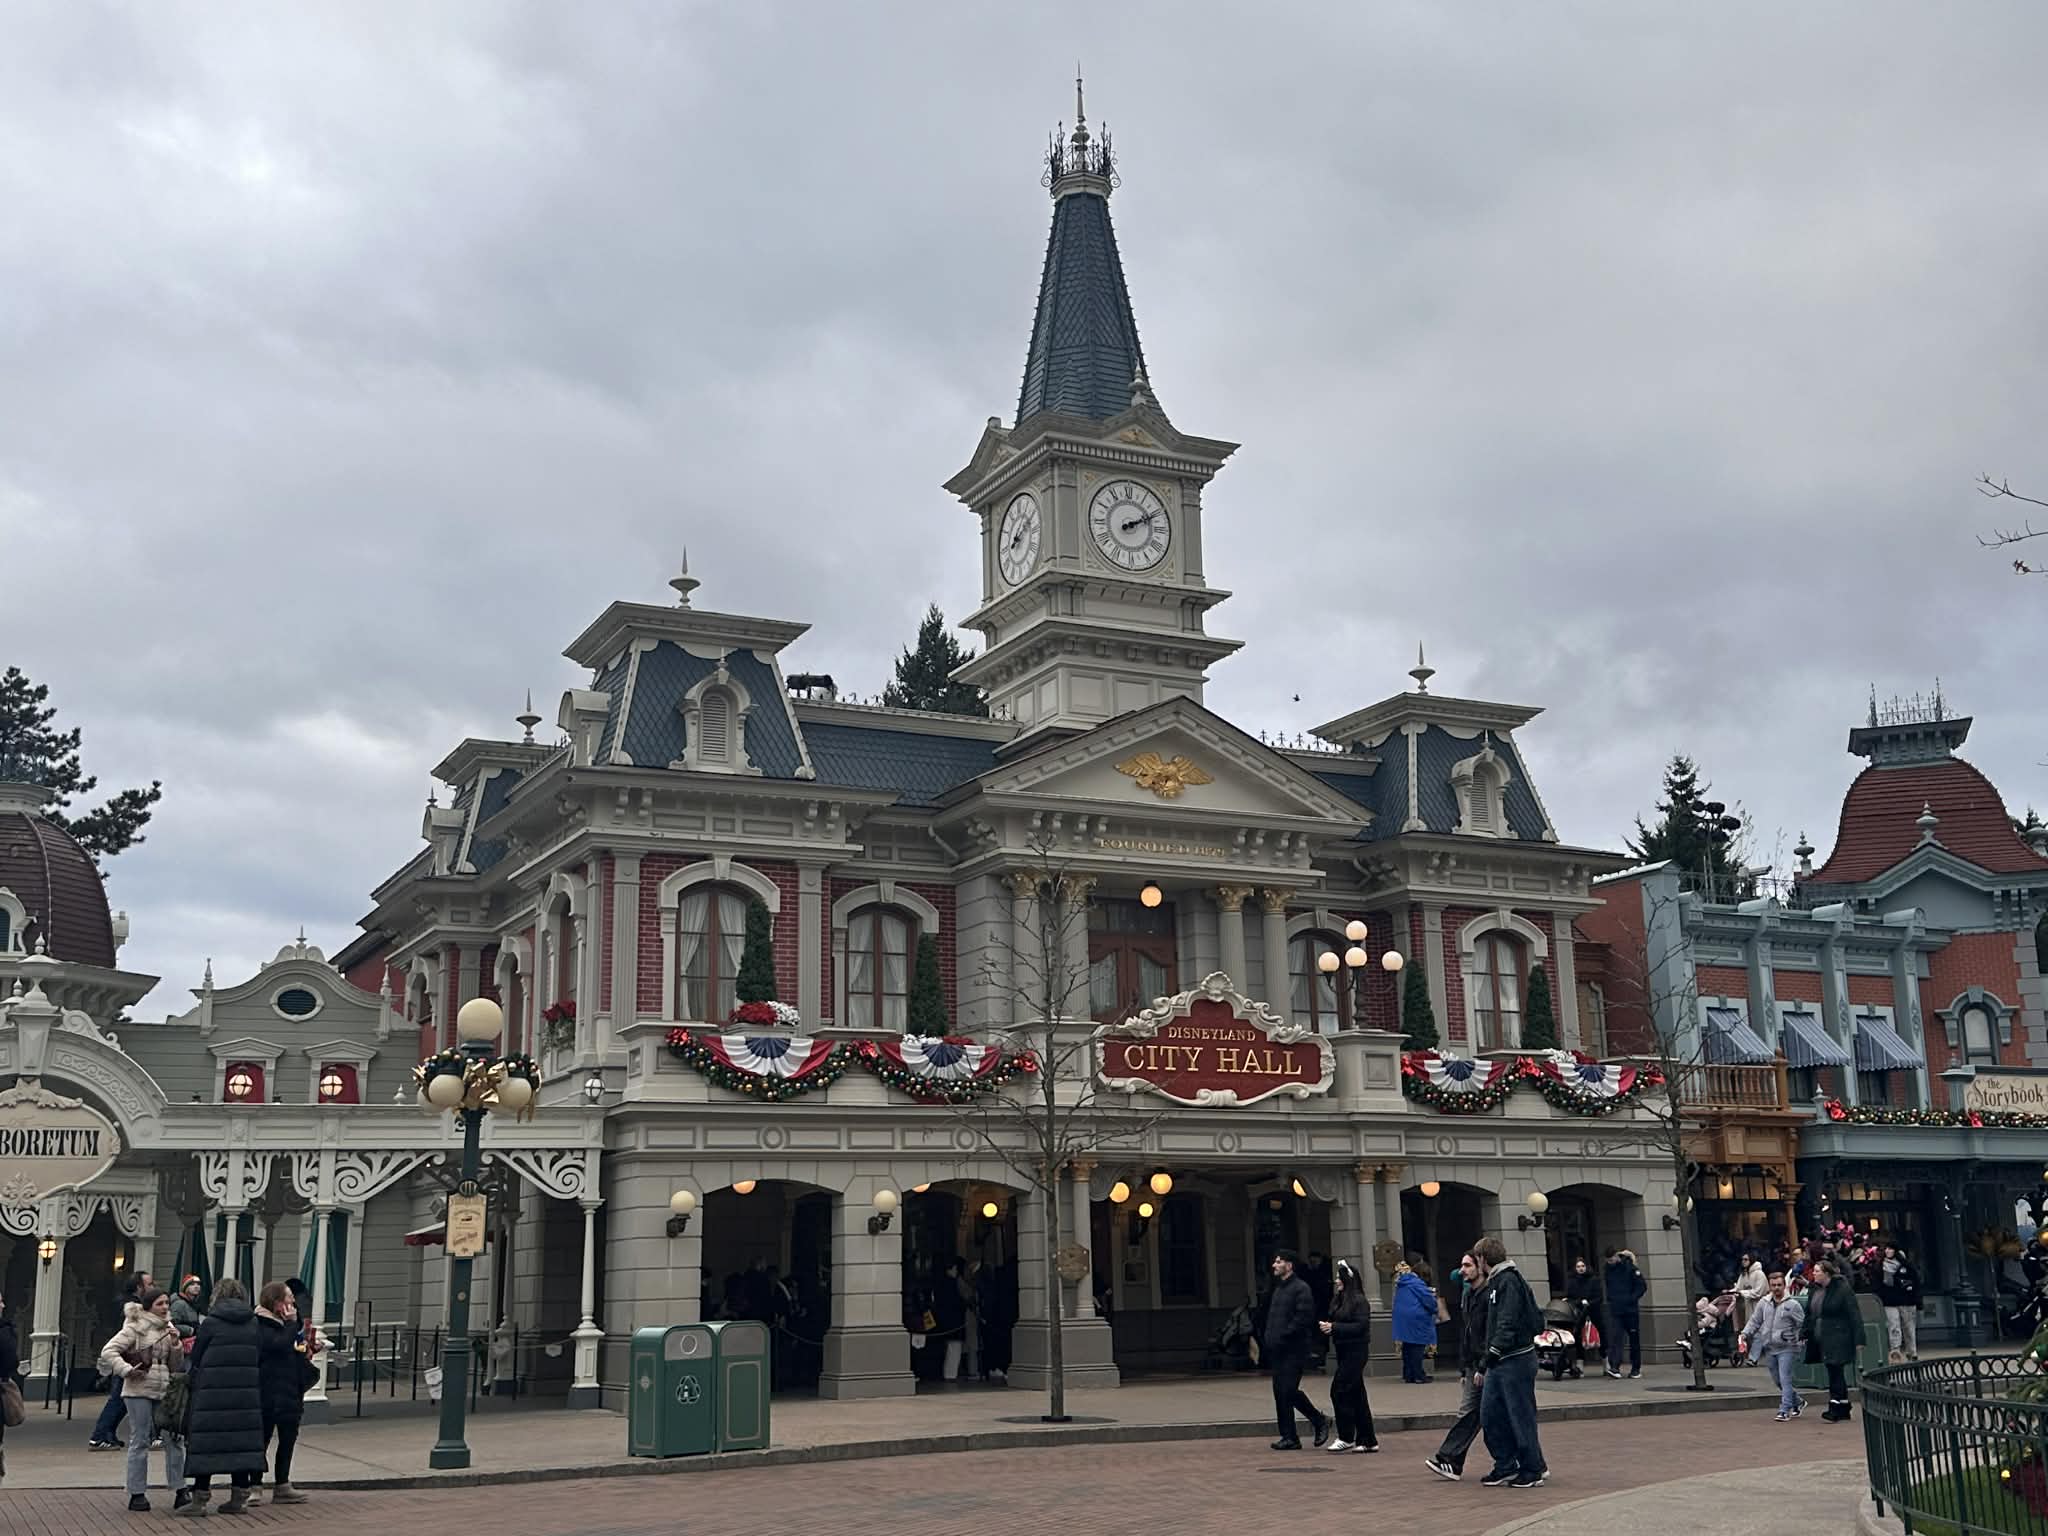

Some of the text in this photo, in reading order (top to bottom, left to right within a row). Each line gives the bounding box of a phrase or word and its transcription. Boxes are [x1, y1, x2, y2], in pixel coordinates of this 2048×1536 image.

[1099, 838, 1190, 854] FOUNDED
[1168, 1026, 1256, 1041] DISNEYLAND
[1123, 1045, 1302, 1075] CITY HALL
[1967, 1080, 2044, 1107] Storybook
[0, 1129, 100, 1155] BORETUM
